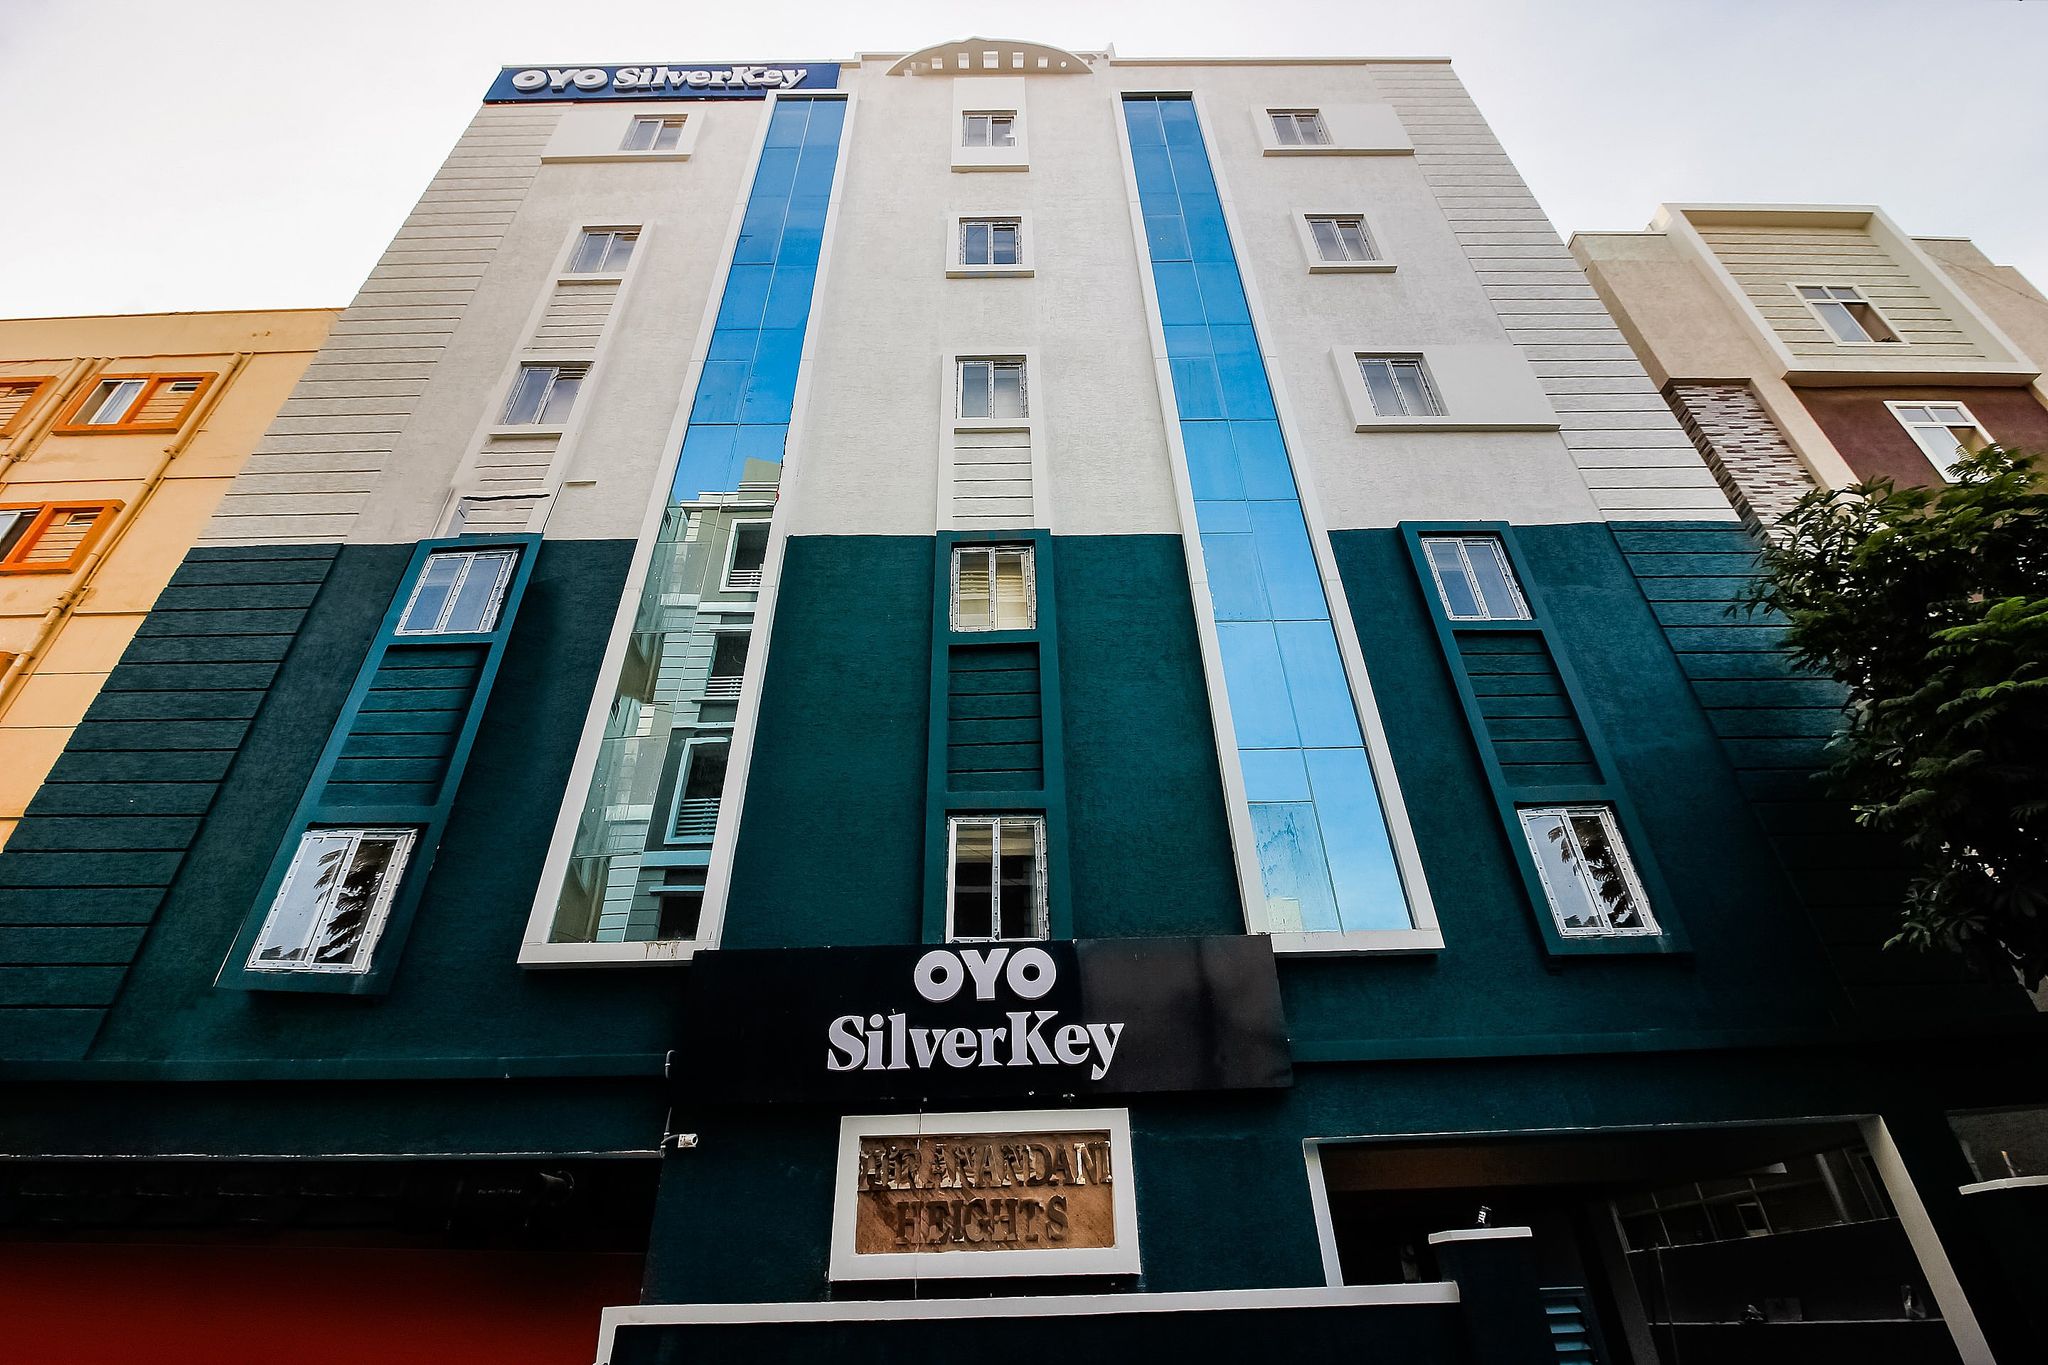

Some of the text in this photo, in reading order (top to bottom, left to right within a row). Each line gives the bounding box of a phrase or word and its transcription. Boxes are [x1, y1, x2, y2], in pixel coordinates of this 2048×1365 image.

[511, 65, 807, 92] OYO SilverKey
[914, 947, 1057, 1002] OYO
[827, 1010, 1125, 1080] SilverKey
[895, 1194, 1069, 1245] HEIGHTS
